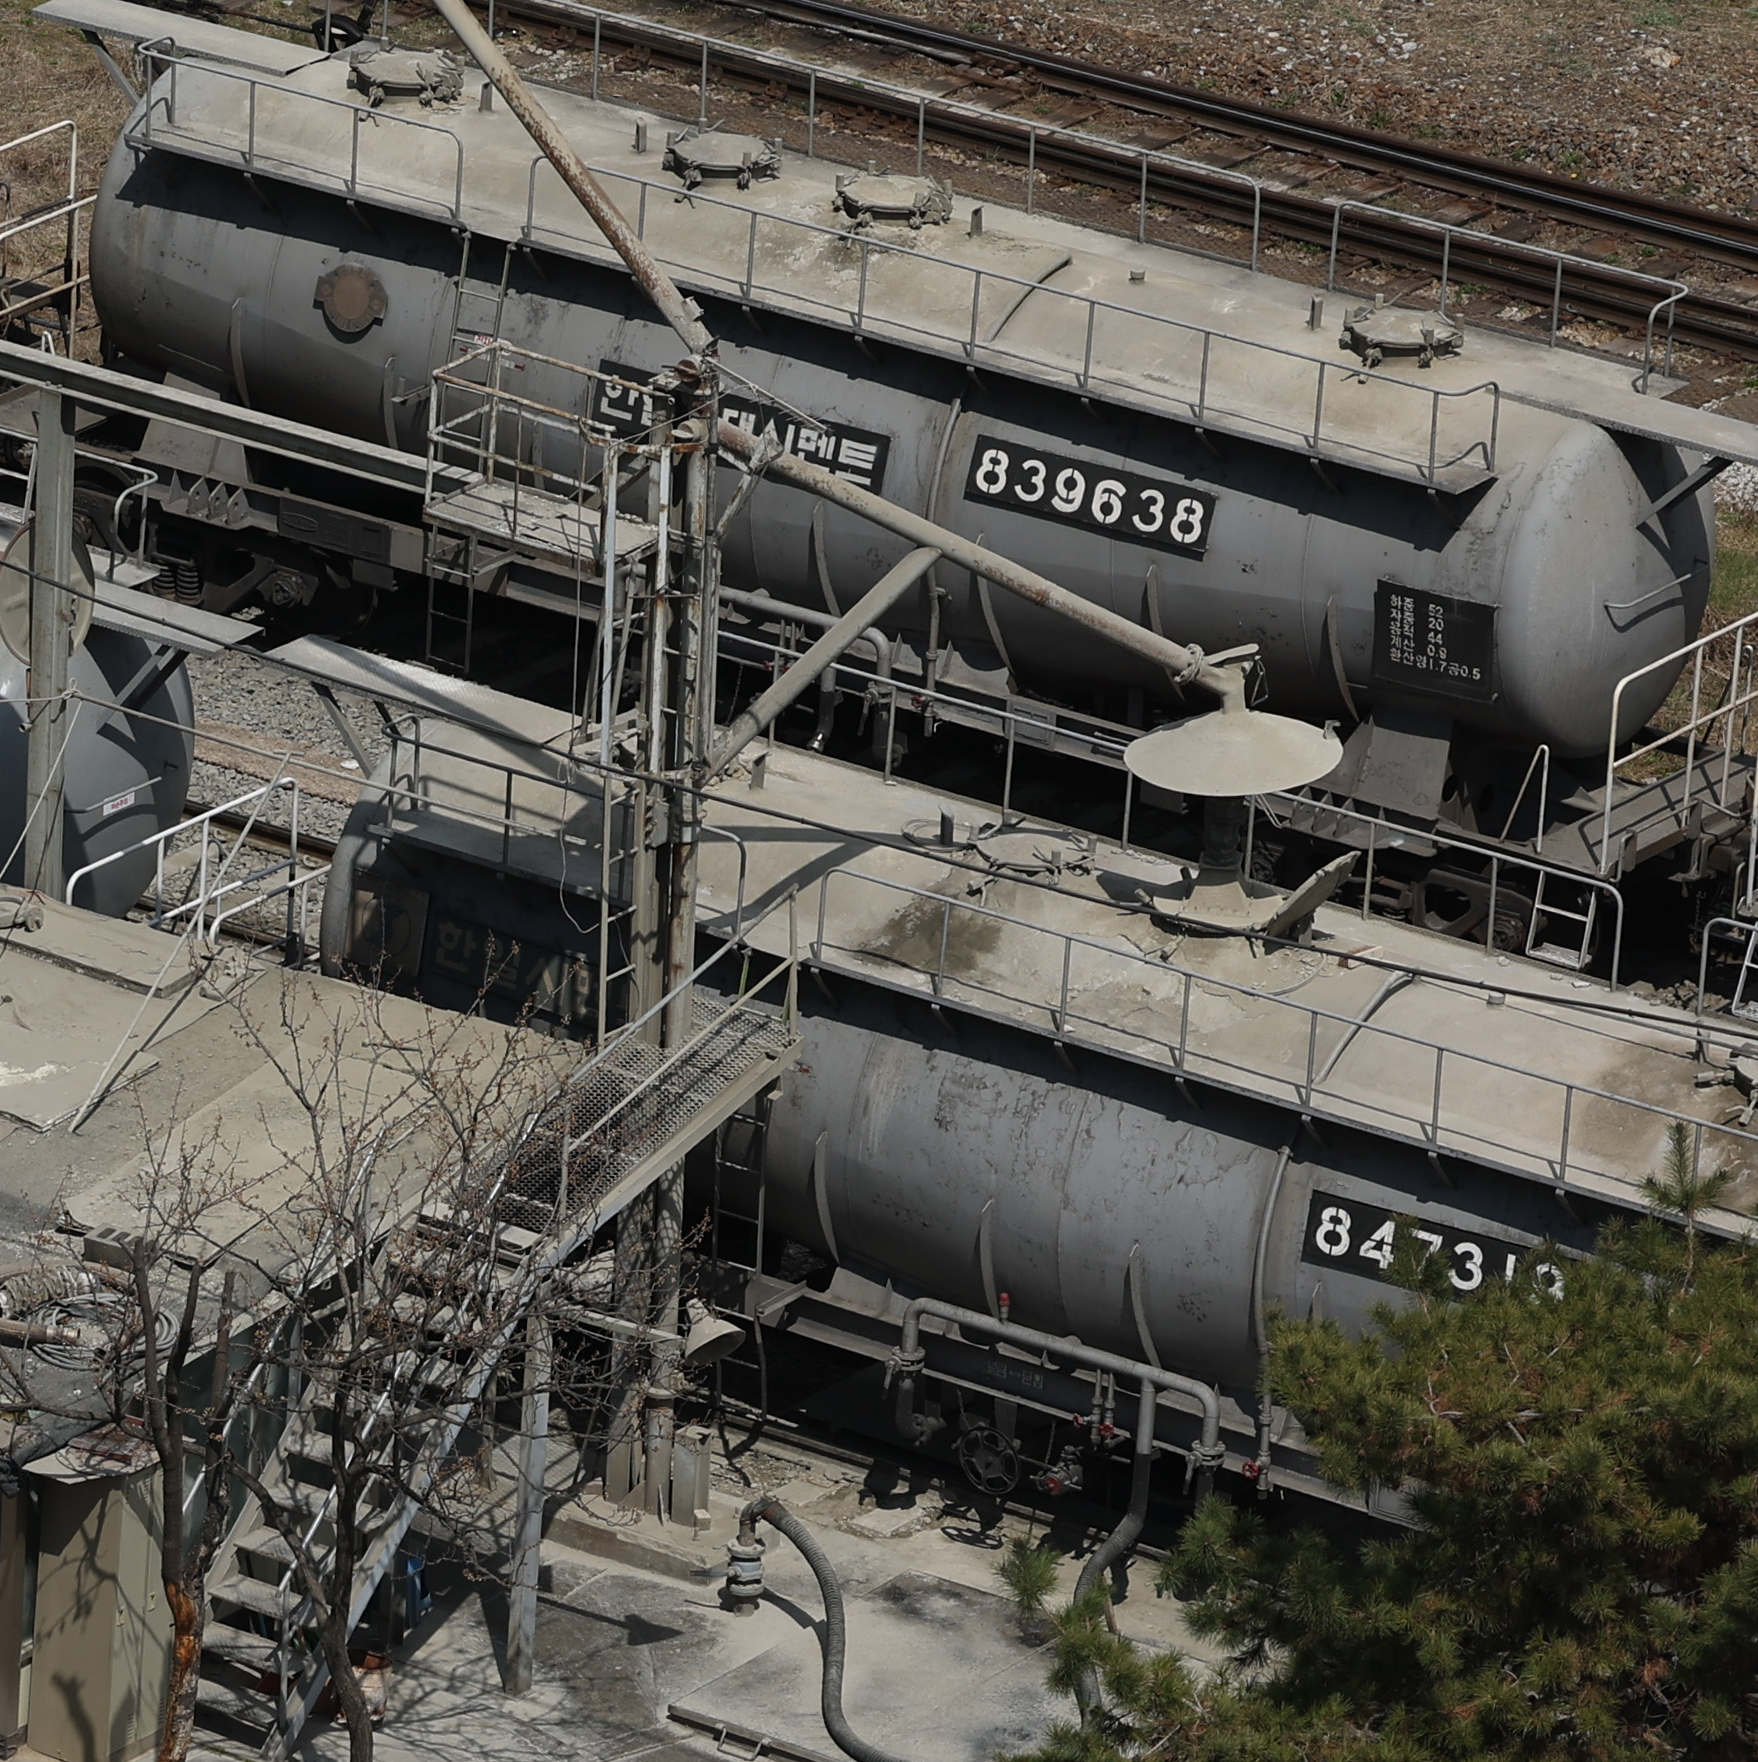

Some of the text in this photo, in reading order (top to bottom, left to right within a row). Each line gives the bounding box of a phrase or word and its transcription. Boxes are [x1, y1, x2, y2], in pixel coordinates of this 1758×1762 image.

[976, 448, 1204, 544] 839638
[1428, 603, 1443, 618] 52
[1428, 618, 1444, 631] 20
[1427, 631, 1442, 645] 44
